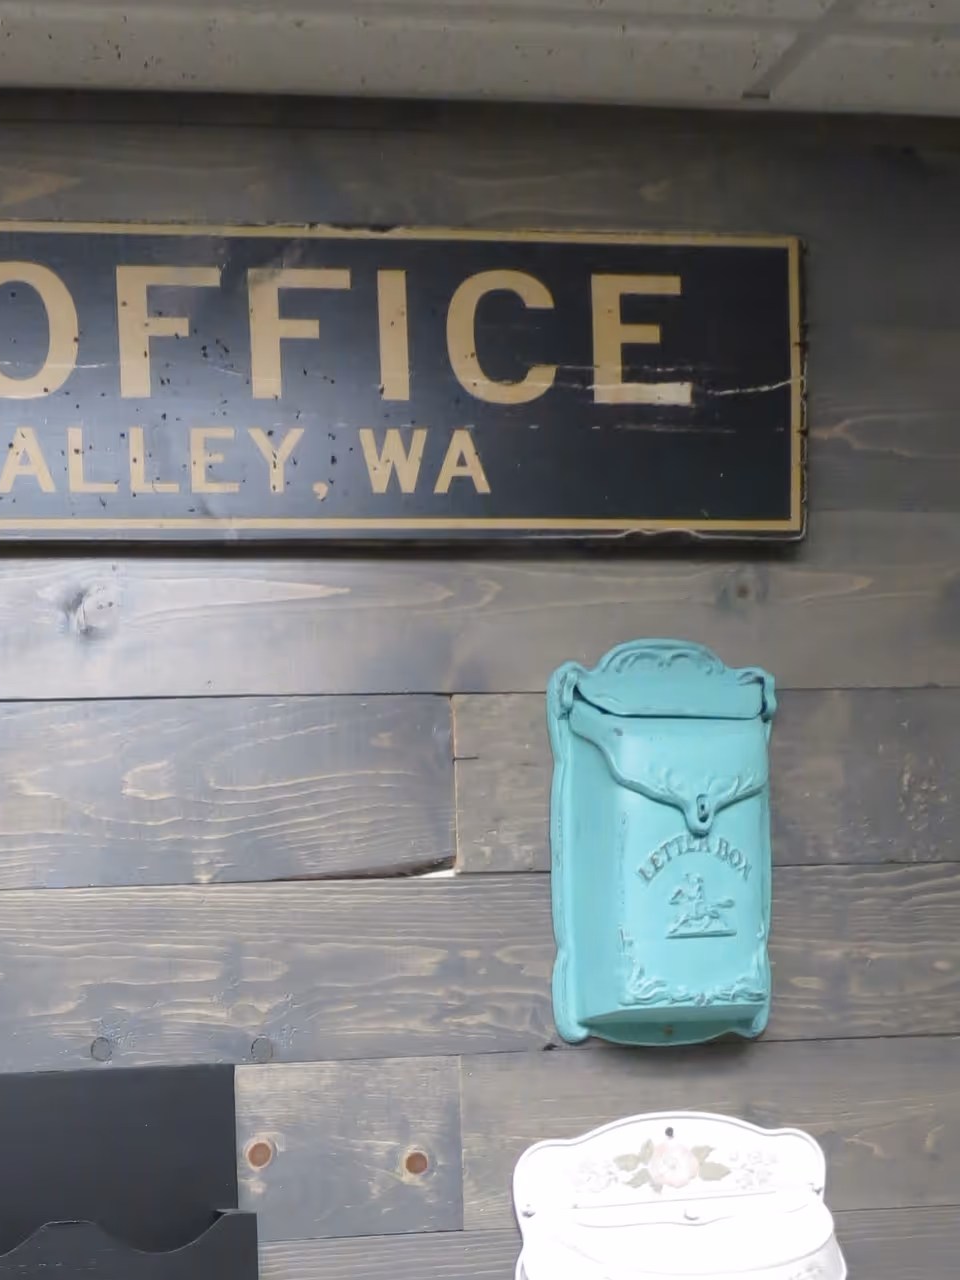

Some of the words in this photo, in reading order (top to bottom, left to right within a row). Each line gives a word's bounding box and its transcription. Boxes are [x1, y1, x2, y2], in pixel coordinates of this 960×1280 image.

[359, 428, 492, 495] WA
[637, 834, 711, 883] LETTER
[716, 837, 752, 880] BOX
